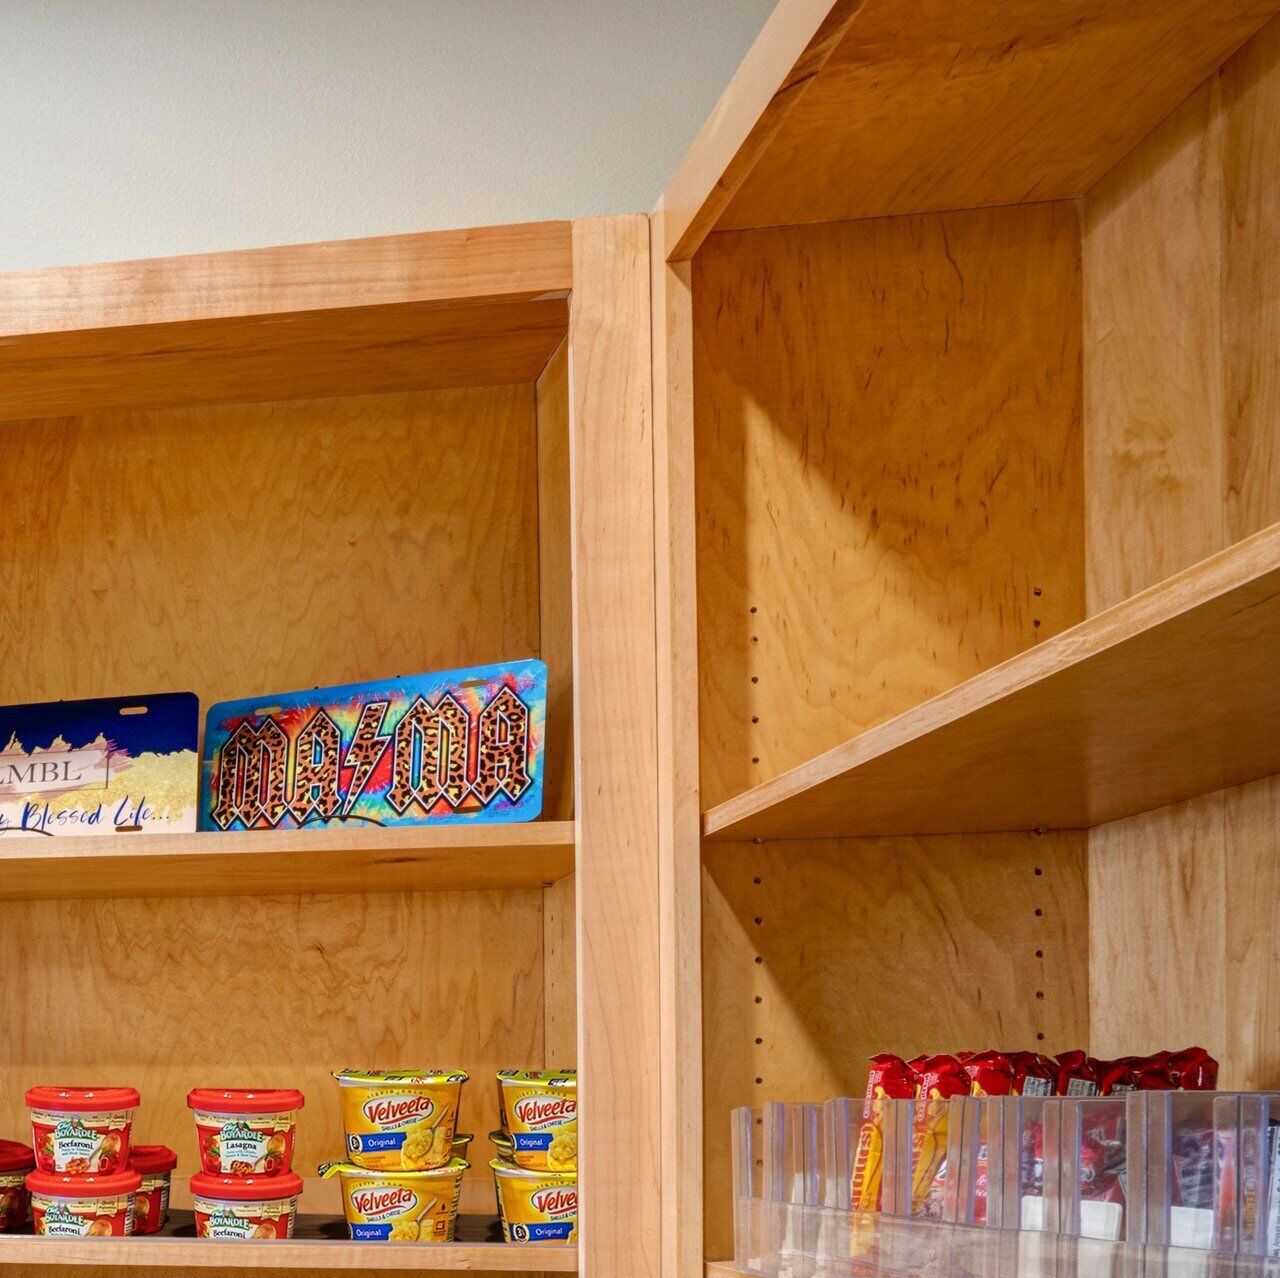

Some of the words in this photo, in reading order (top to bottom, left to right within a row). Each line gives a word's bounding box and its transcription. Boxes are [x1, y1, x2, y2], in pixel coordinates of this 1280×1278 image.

[20, 801, 103, 831] Blessed
[366, 1096, 431, 1124] Velveeta
[518, 1099, 577, 1123] Velveeta
[58, 1140, 93, 1150] Beefaroni
[226, 1142, 257, 1151] Lasagna
[368, 1138, 396, 1148] Original
[519, 1138, 543, 1147] Original
[353, 1187, 413, 1213] Velveeta
[48, 1225, 81, 1235] Beefaroni
[356, 1228, 382, 1239] Original
[535, 1227, 563, 1237] Original
